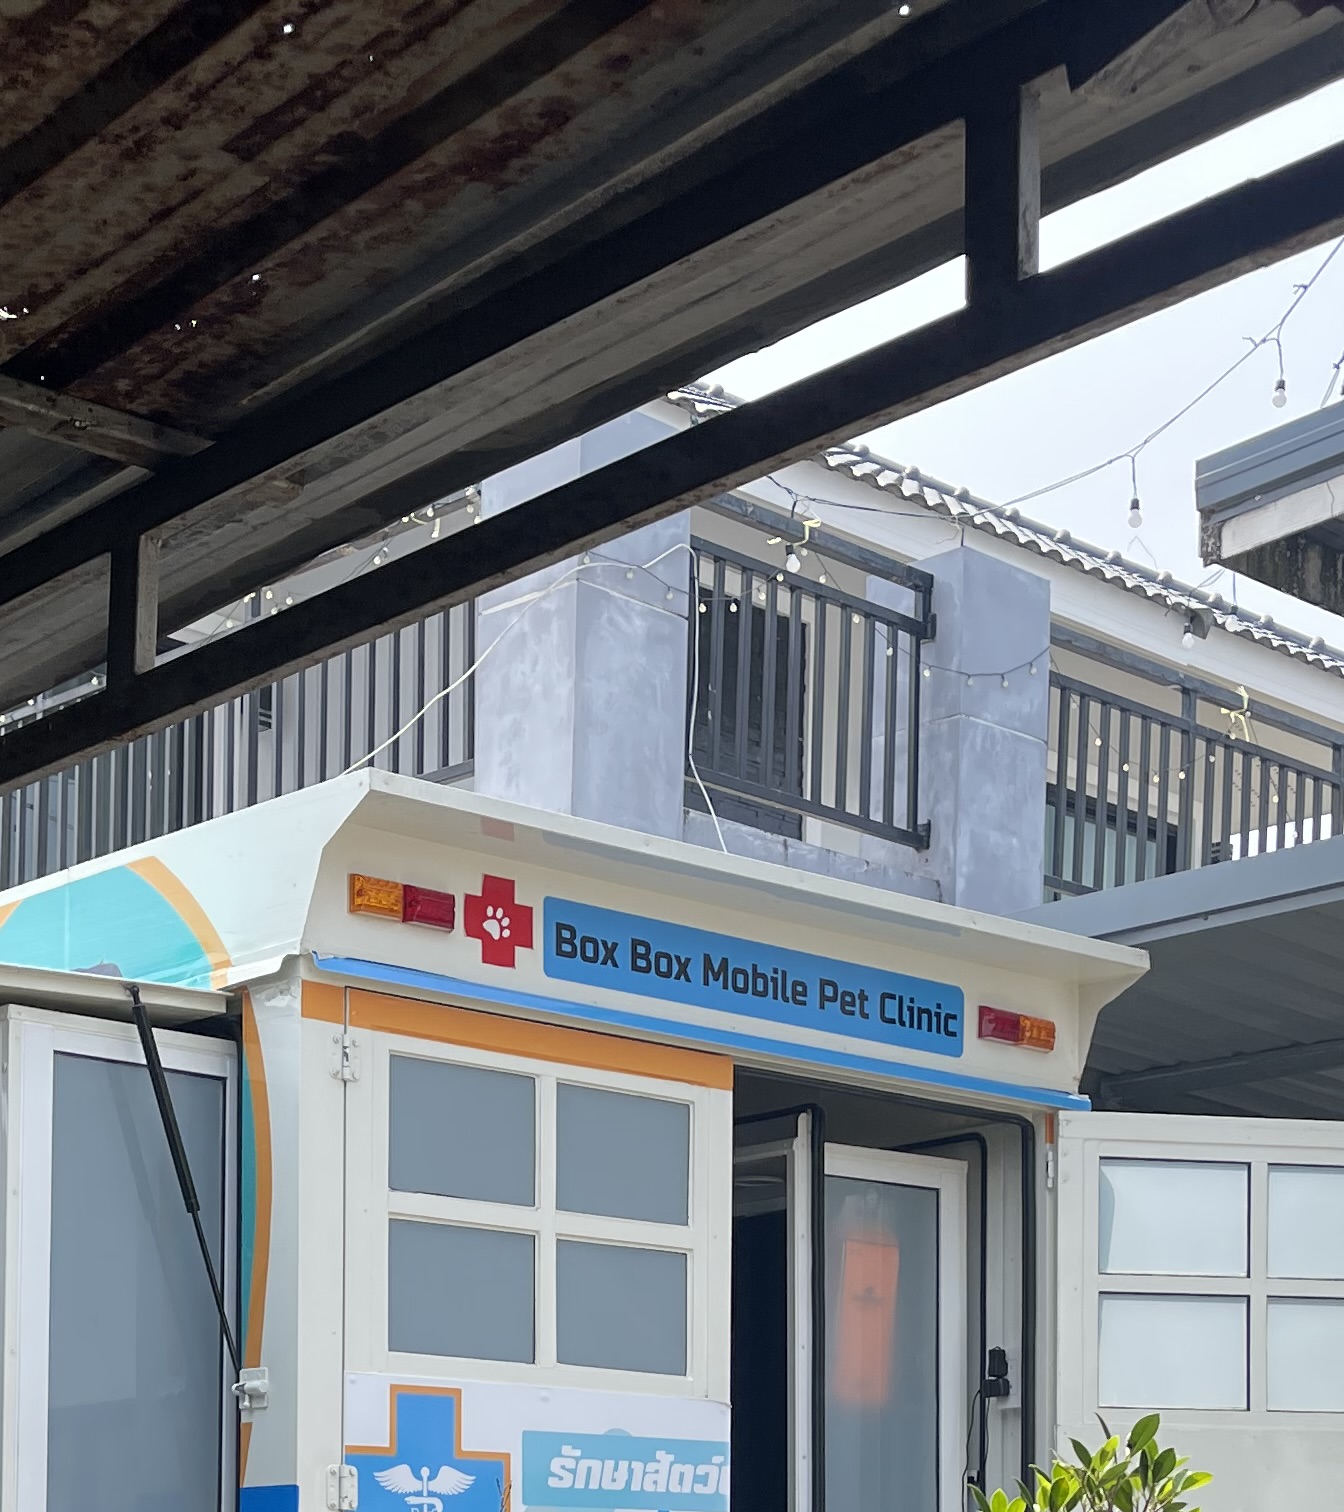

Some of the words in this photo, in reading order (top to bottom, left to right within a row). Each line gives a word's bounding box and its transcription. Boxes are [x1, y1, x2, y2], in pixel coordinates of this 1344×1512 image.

[555, 920, 620, 969] Box
[631, 935, 692, 985] Box
[702, 952, 808, 1007] Mobile
[818, 978, 870, 1022] Pet
[878, 991, 958, 1039] Clinic
